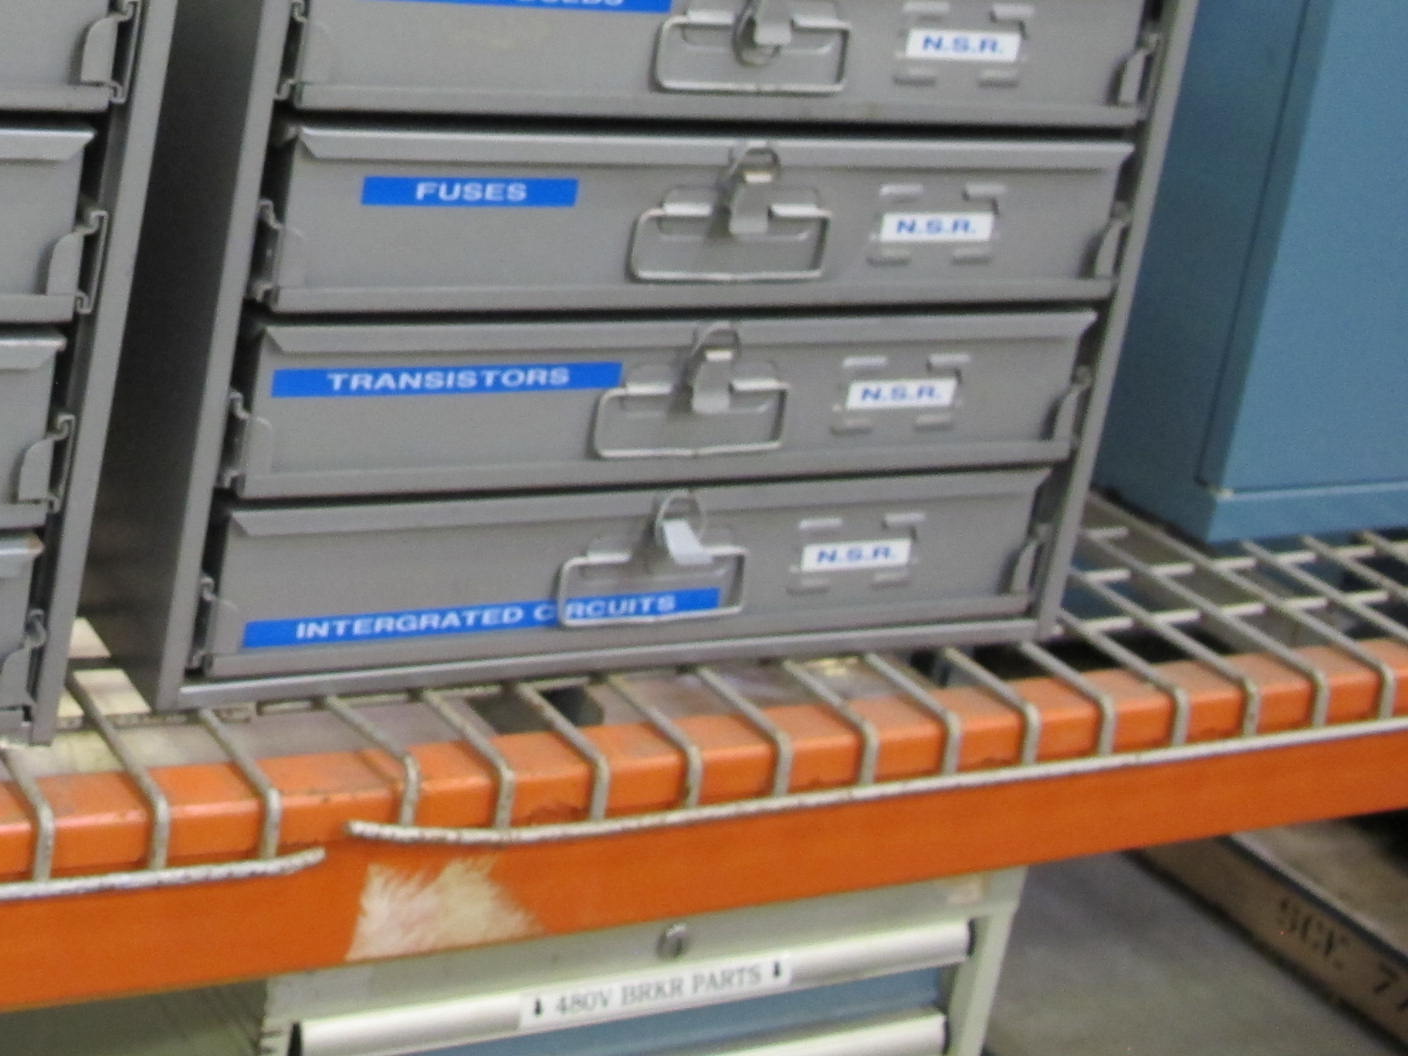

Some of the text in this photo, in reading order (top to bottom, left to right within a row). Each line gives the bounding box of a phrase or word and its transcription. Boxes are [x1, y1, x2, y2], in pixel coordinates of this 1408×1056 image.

[415, 181, 528, 202] FUSES
[326, 366, 570, 391] TRANSISTORS
[296, 594, 676, 640] INTERGRATED CRCUITS
[556, 965, 761, 1014] 480V BRKR PARTS
